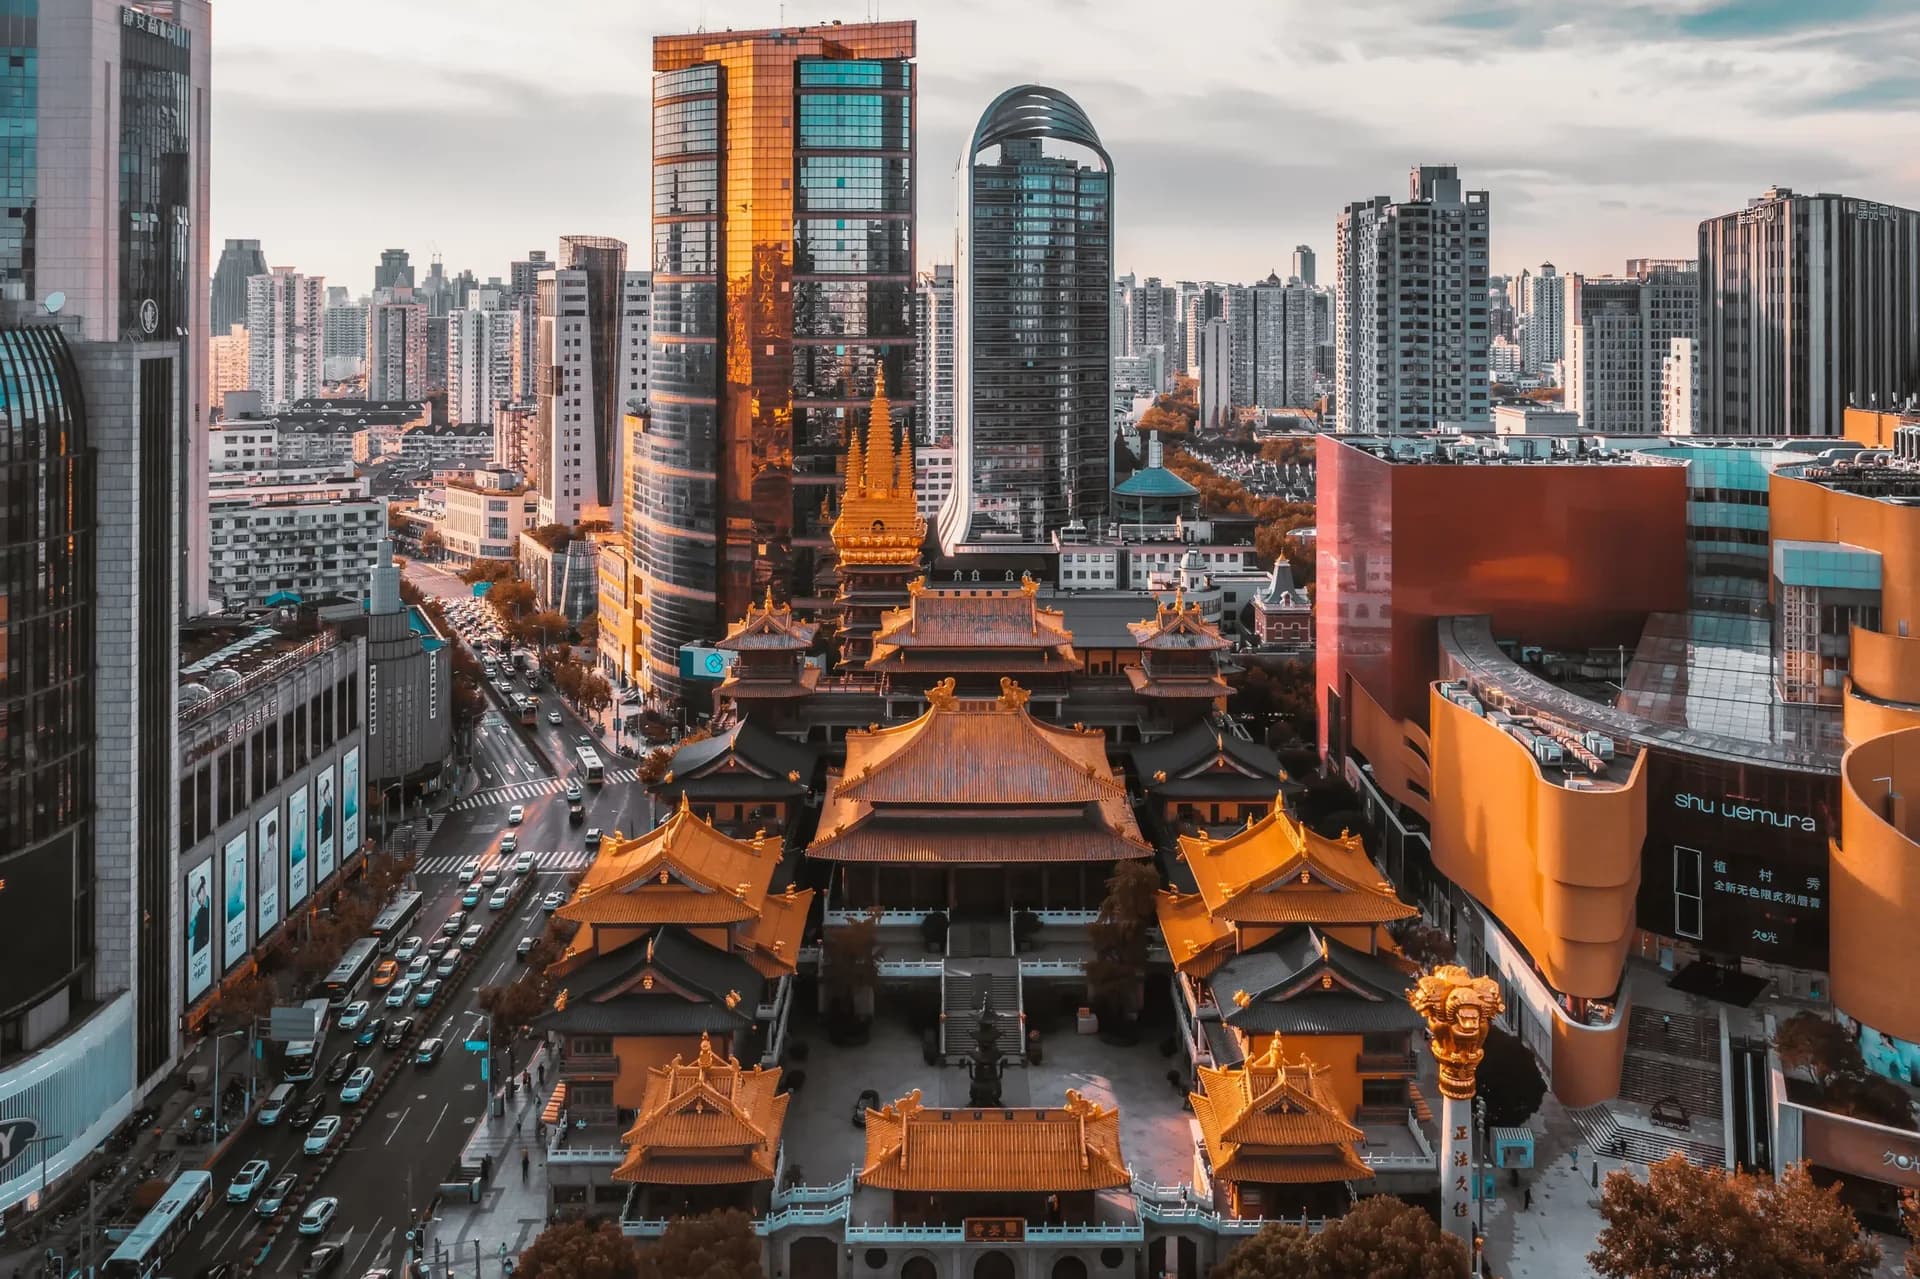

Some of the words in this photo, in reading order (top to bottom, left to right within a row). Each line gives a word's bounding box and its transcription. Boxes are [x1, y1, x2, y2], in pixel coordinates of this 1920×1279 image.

[1674, 792, 1715, 814] shu
[1721, 802, 1816, 832] uemura
[1452, 1125, 1469, 1218] 正法久住
